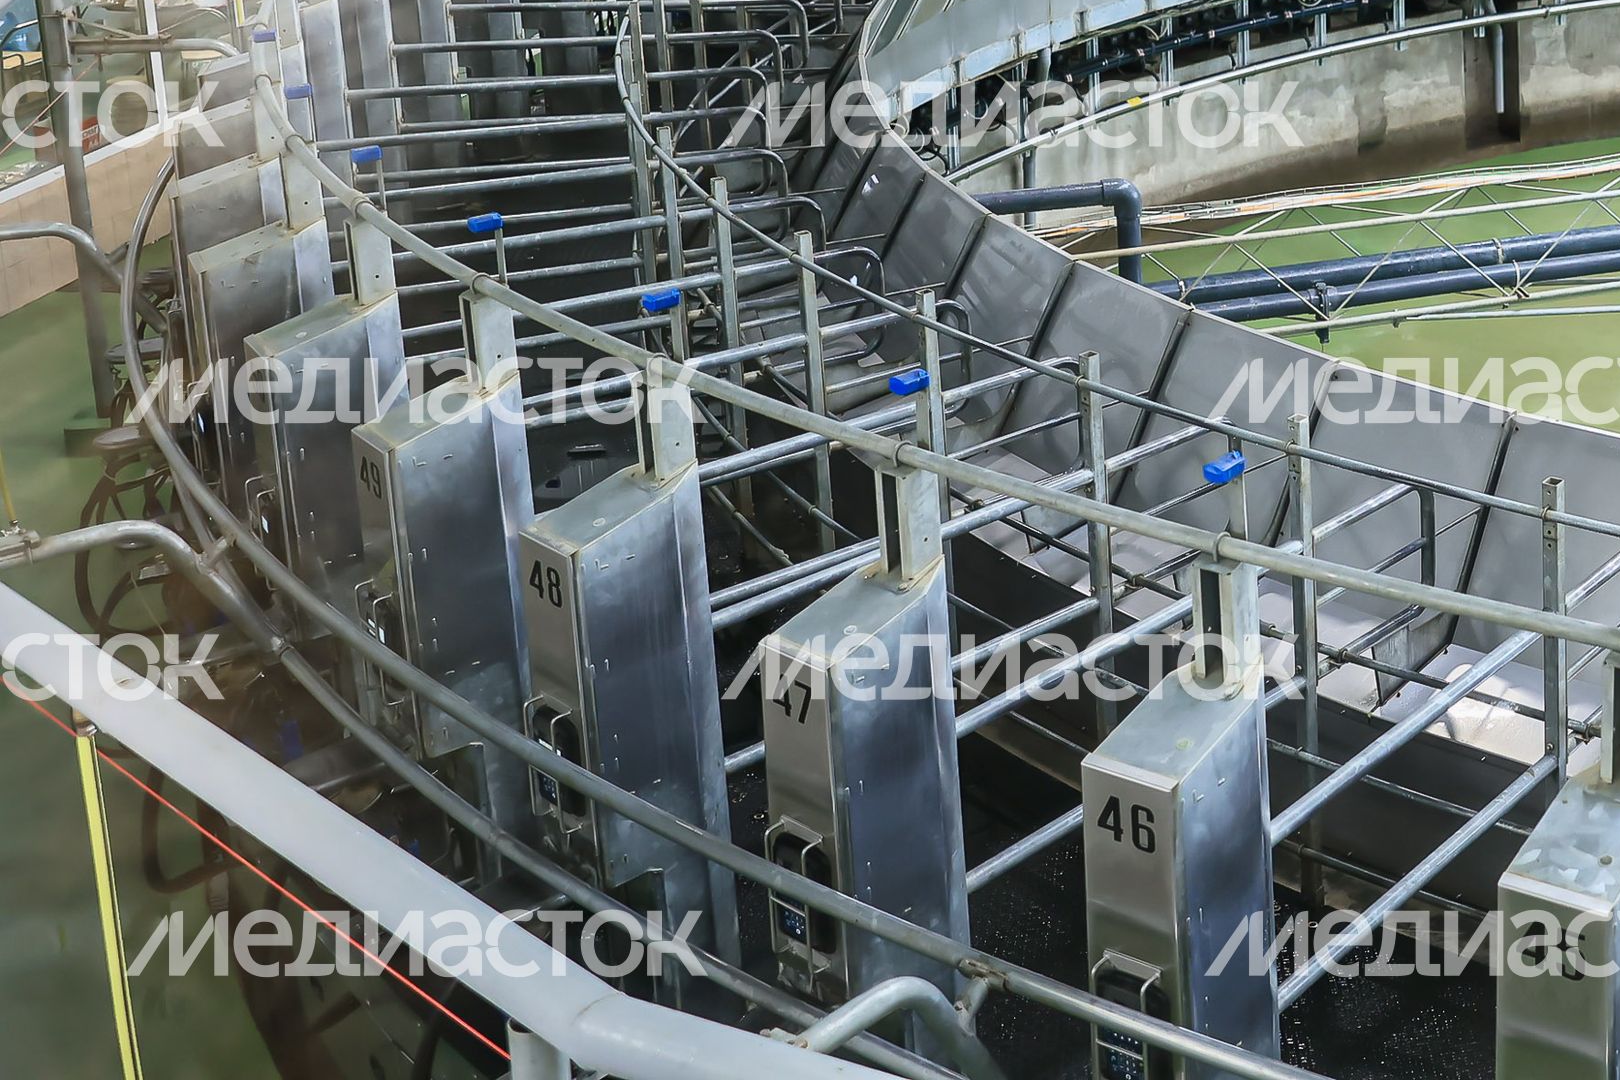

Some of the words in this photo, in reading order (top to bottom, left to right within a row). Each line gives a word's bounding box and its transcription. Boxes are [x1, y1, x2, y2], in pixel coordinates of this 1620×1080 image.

[360, 456, 381, 499] 49
[529, 560, 562, 608] 48
[772, 673, 812, 724] 47
[1097, 795, 1156, 854] 46
